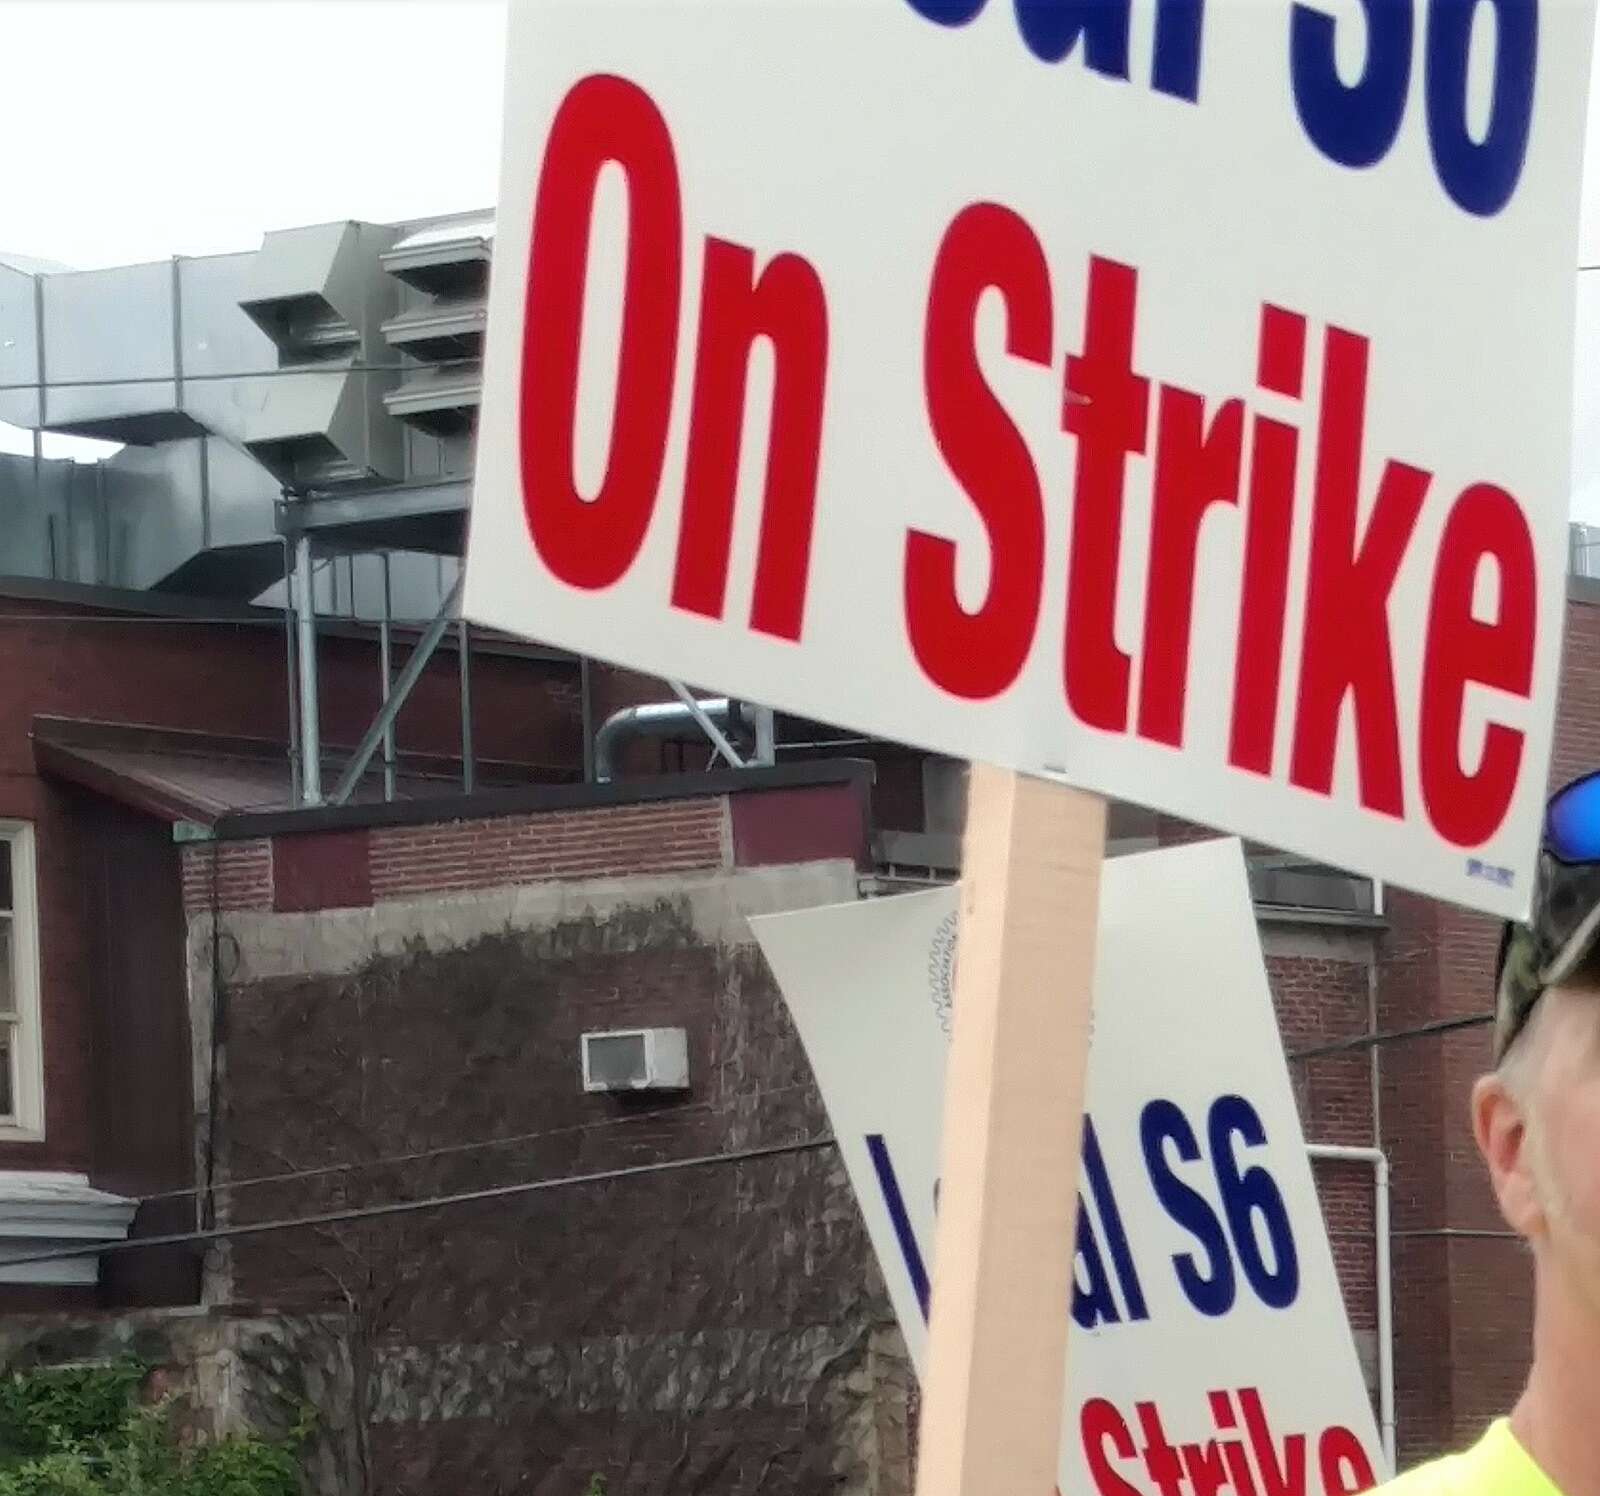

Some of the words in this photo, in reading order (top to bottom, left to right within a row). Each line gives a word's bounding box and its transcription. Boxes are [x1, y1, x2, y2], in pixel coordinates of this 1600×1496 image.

[517, 73, 830, 645] On
[903, 201, 1539, 849] Strike
[1138, 1095, 1300, 1318] S6
